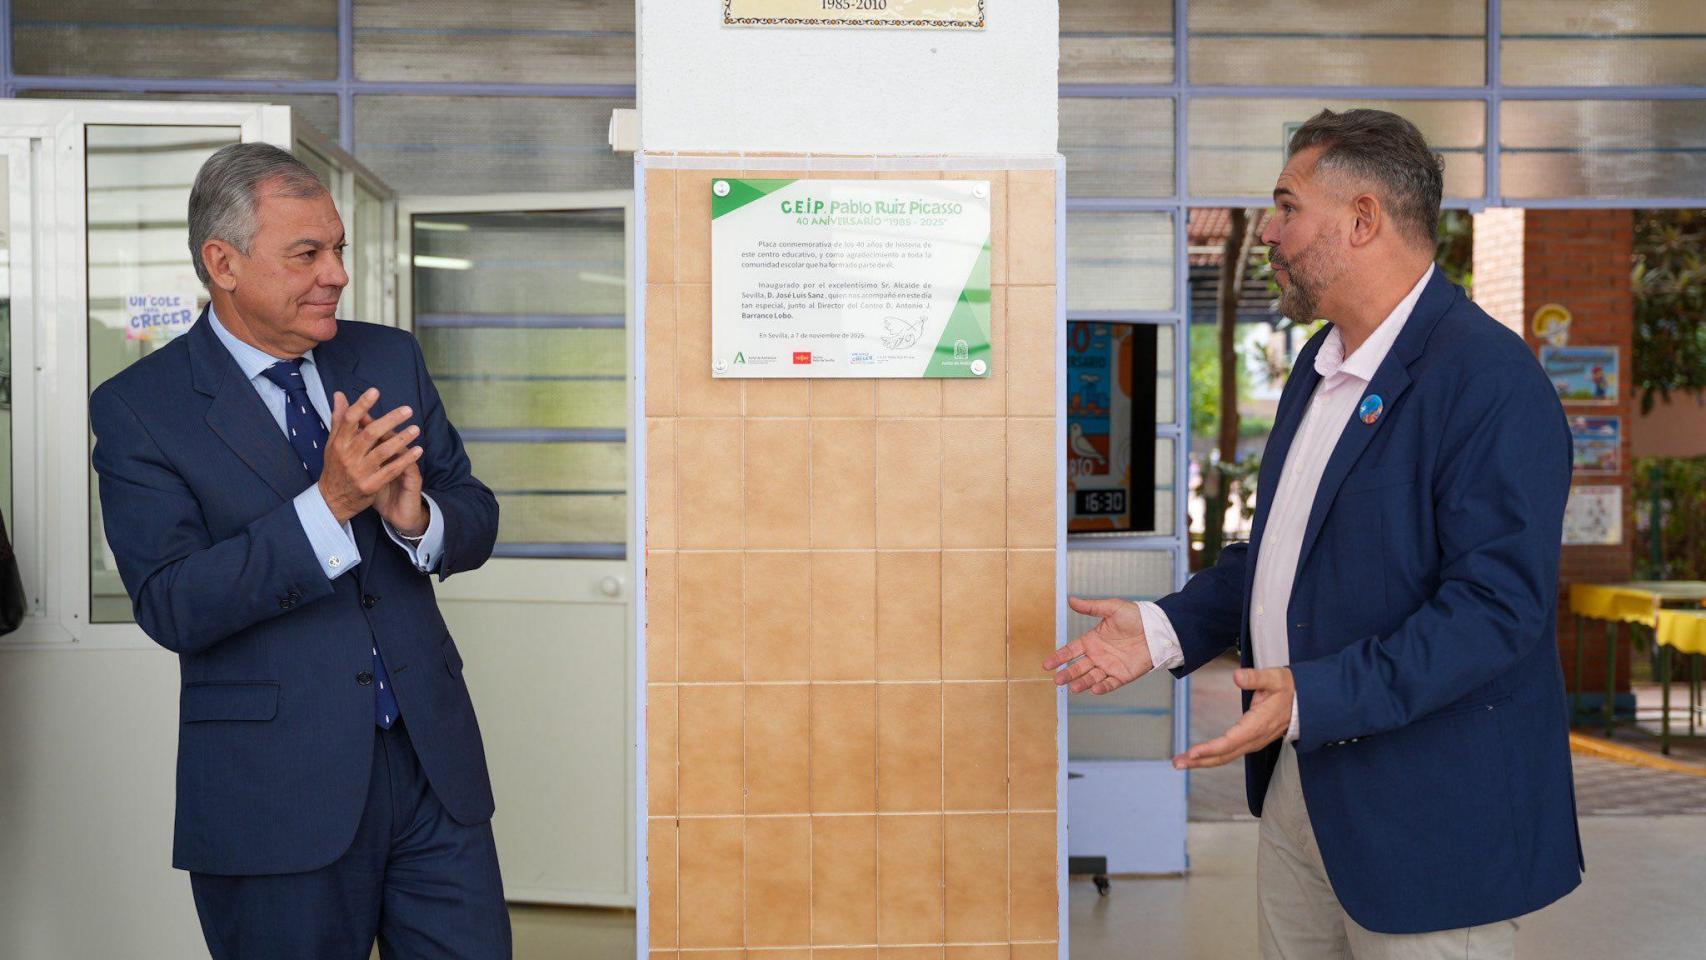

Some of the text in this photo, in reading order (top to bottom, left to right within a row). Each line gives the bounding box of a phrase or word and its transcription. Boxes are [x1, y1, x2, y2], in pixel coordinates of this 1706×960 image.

[822, 0, 887, 10] 1985-2010
[829, 199, 872, 214] Pablo
[875, 199, 906, 214] Ruiz
[909, 199, 962, 214] Picasso
[796, 217, 809, 225] 40
[805, 262, 818, 270] que
[758, 282, 800, 290] Inaugurado
[741, 292, 767, 300] Sevilla,
[129, 296, 181, 307] UN COLE
[755, 302, 786, 310] especial,
[1085, 492, 1123, 512] 16:30
